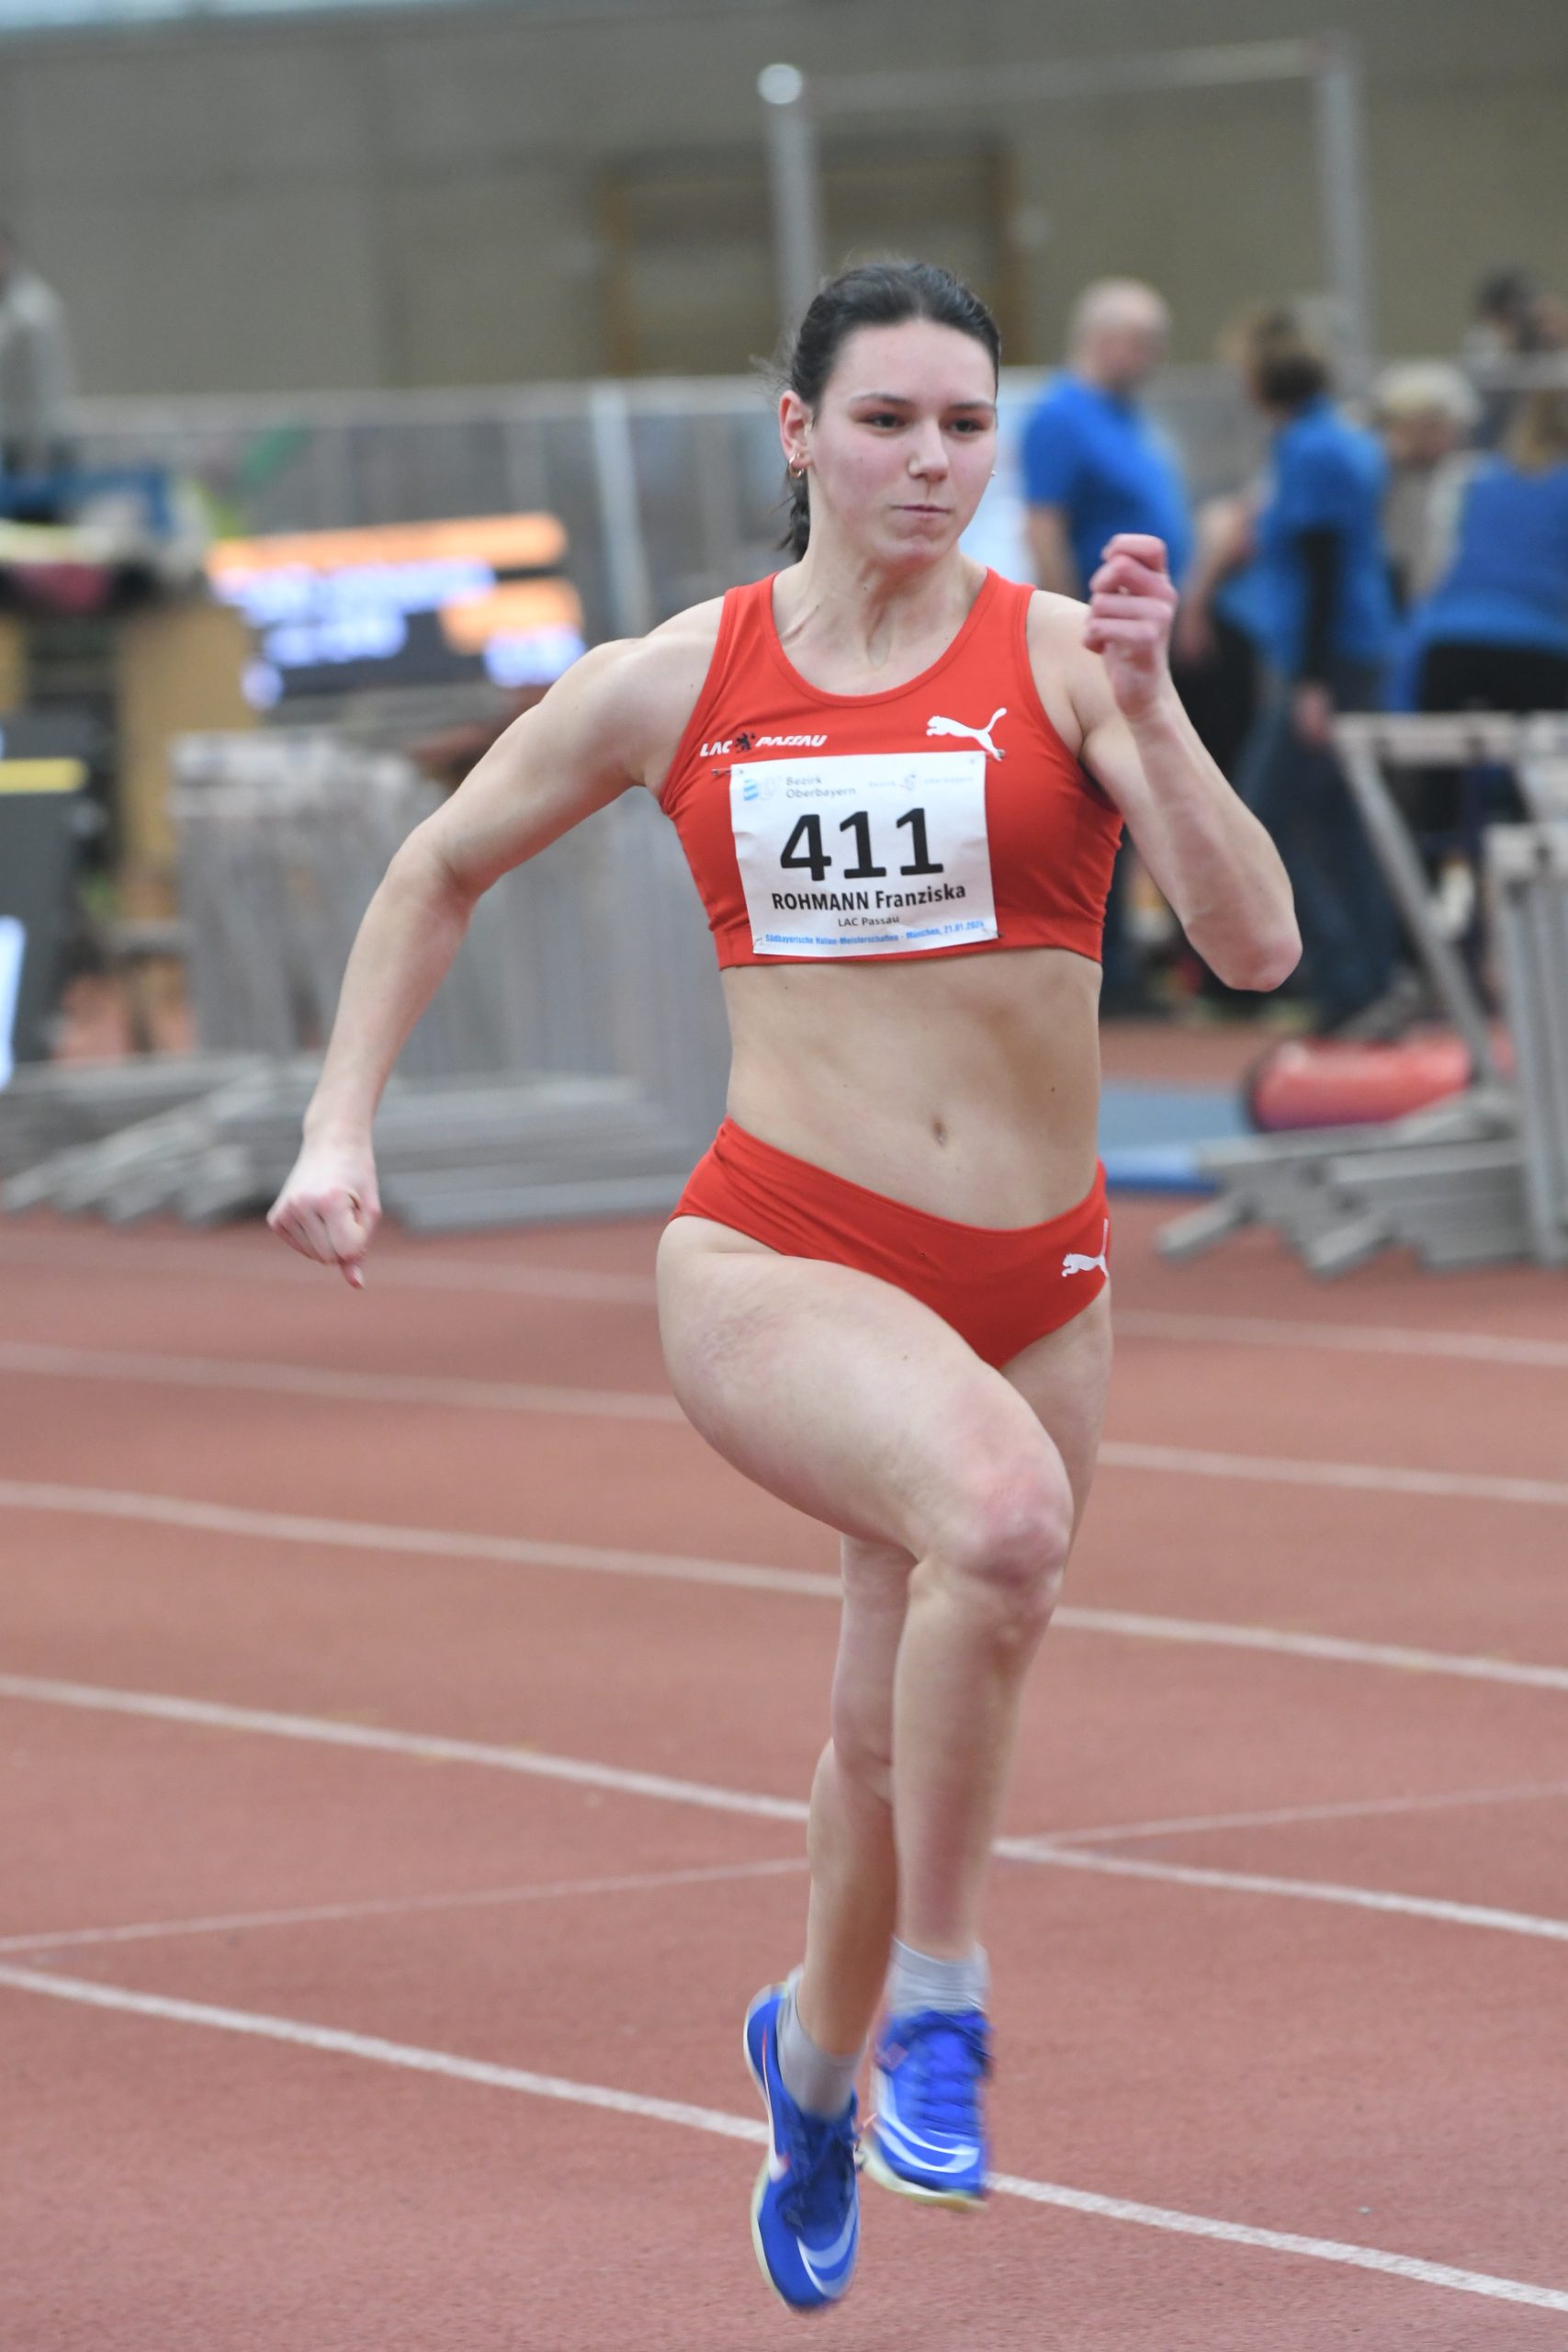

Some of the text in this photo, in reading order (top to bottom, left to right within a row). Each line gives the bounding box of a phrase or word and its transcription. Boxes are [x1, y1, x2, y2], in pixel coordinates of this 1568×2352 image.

[700, 735, 827, 757] LAC PASSAU
[780, 808, 944, 881] 411
[772, 883, 965, 911] ROHMANN Franziska
[838, 916, 899, 927] LAC Passau
